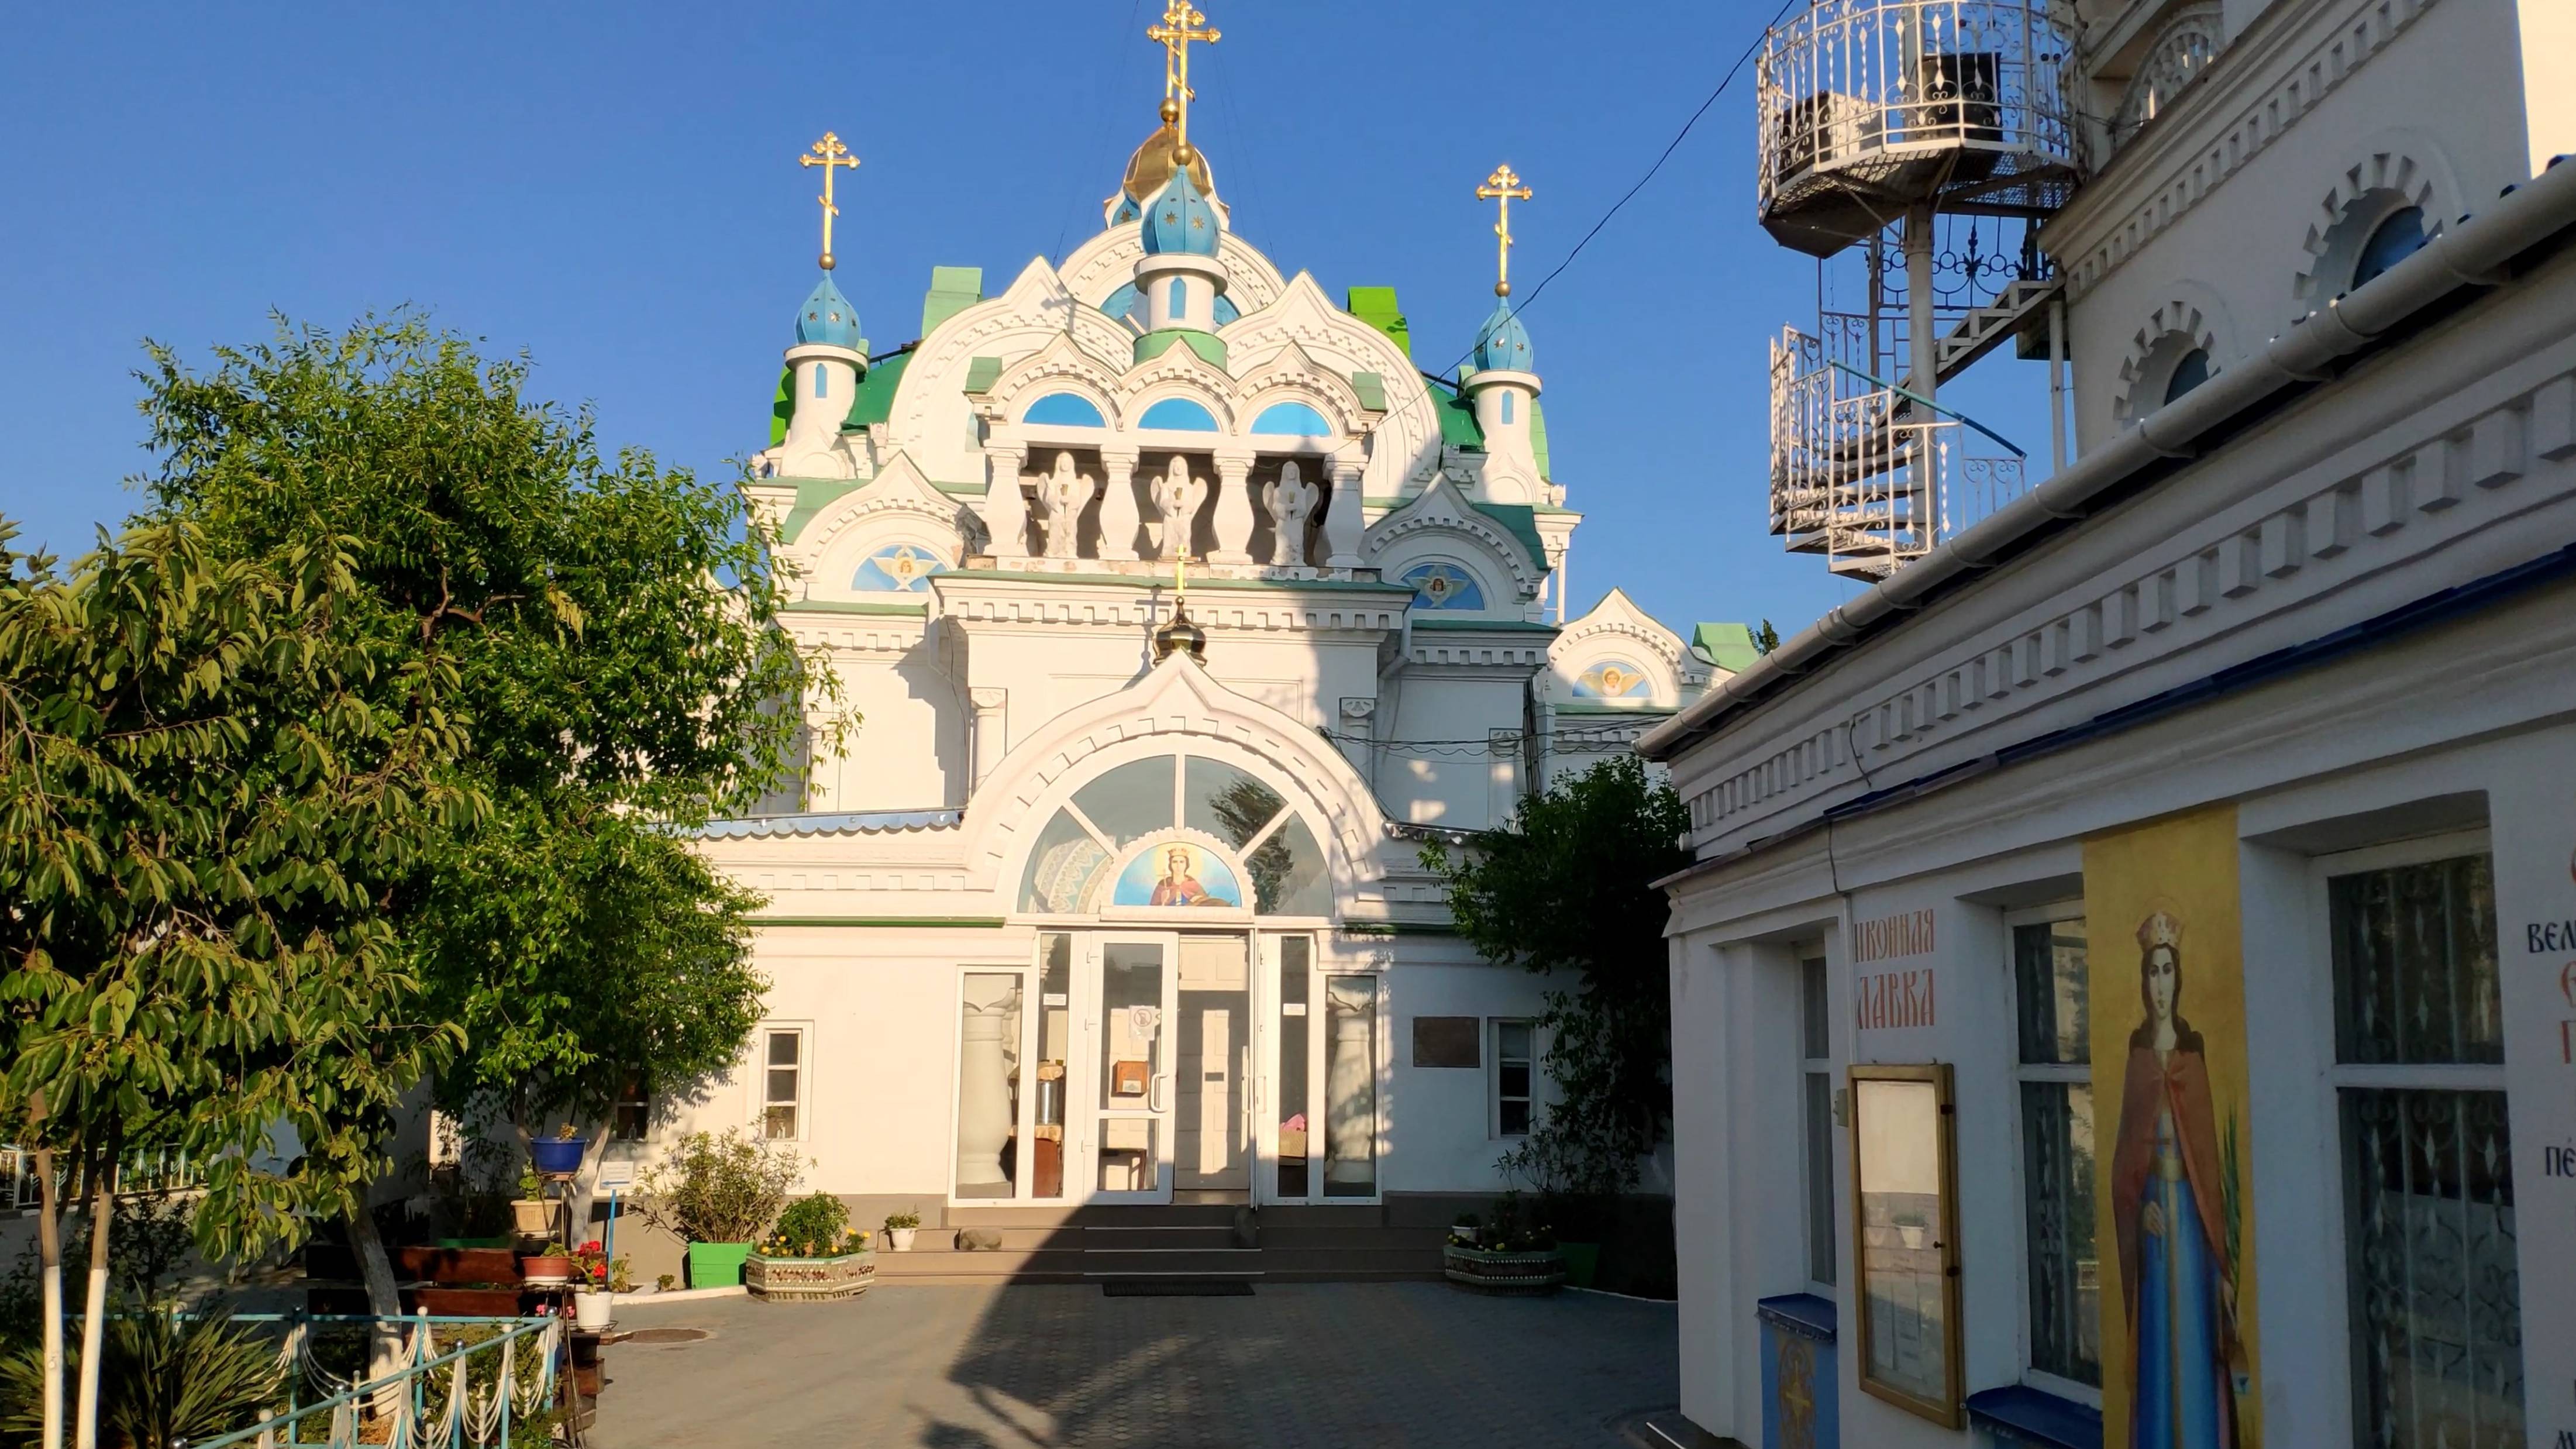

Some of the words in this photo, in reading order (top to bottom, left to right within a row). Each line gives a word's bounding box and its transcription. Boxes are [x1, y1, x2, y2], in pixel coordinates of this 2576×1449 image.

[1854, 908, 1934, 963] ИКОННАЯ
[2527, 920, 2576, 954] ВЕЛ
[1857, 968, 1935, 1030] ЛАВКА
